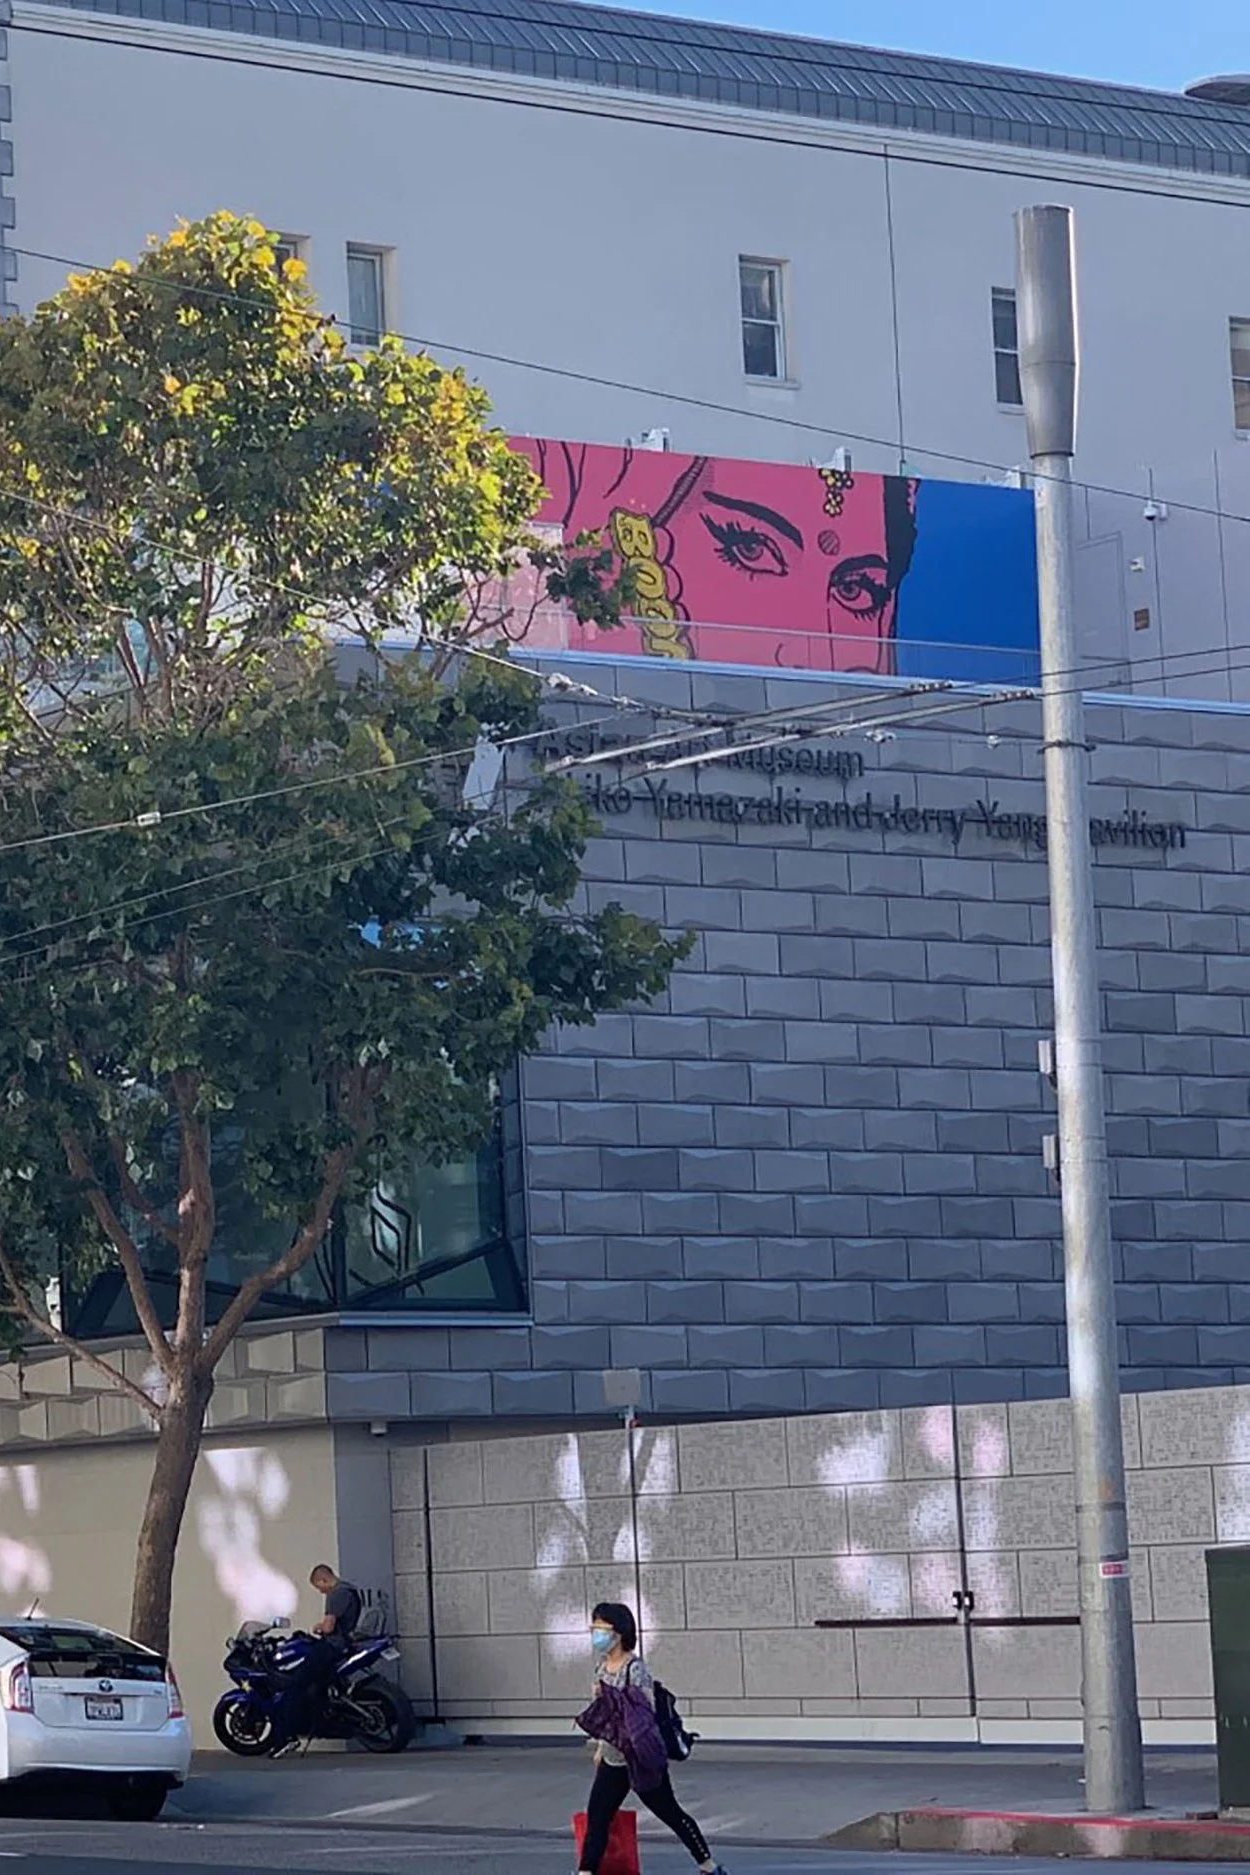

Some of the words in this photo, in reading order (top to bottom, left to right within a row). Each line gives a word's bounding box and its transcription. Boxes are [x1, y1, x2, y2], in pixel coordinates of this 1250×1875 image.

[643, 776, 801, 826] Yamazaki
[812, 791, 873, 830] and
[883, 793, 967, 845] Jerry
[1089, 809, 1187, 850] avilion
